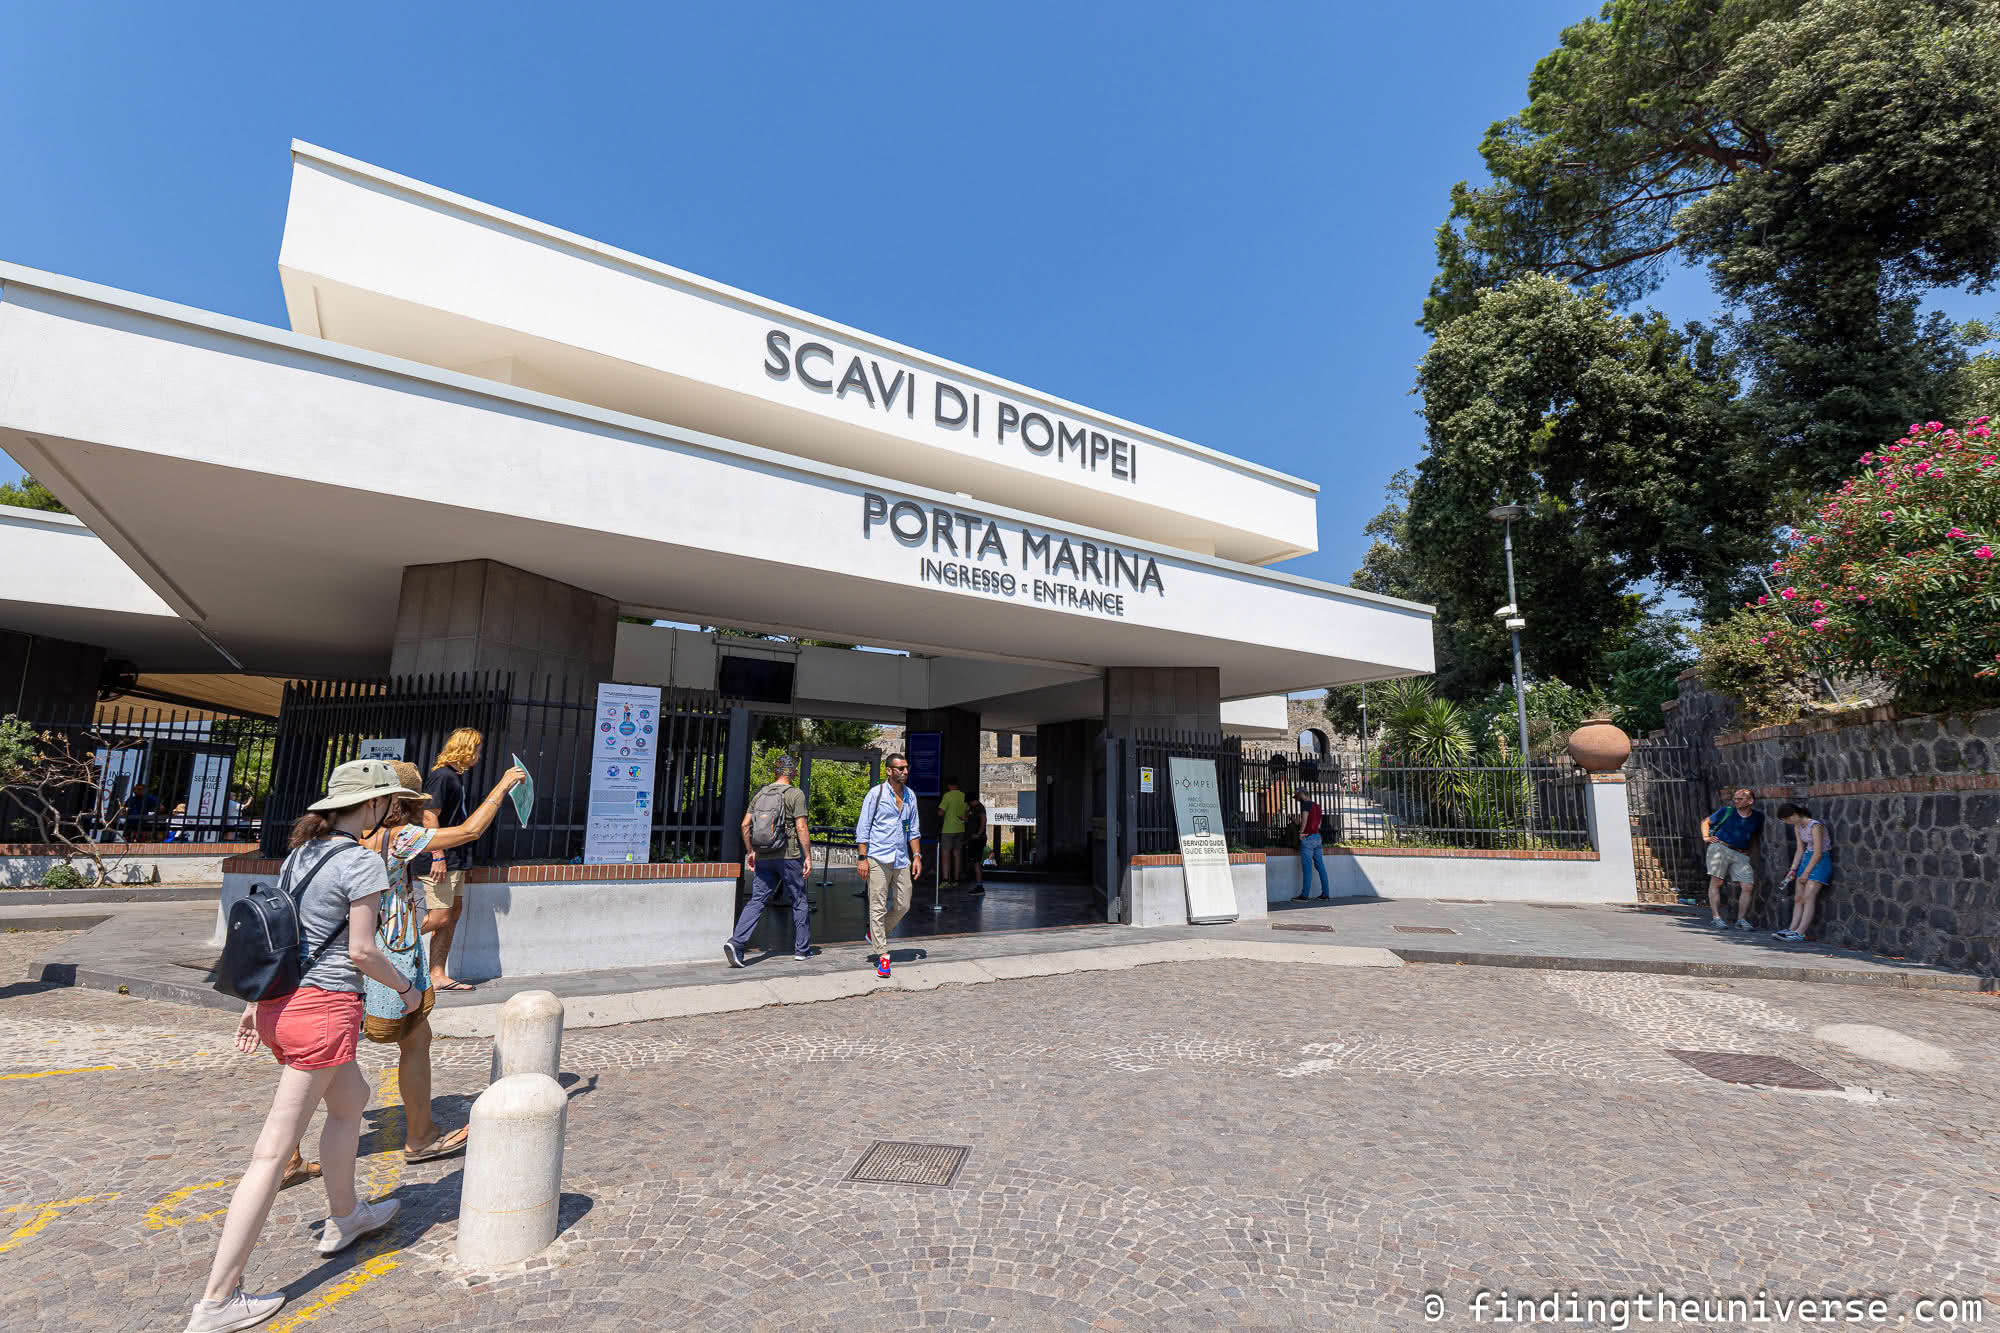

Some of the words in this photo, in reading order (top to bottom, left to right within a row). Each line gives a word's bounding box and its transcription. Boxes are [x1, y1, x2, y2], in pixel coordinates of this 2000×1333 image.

[764, 329, 914, 416] SCAVI
[935, 381, 980, 434] DI
[998, 401, 1137, 480] POMPEI
[863, 492, 1008, 560] PORTA
[1022, 528, 1165, 593] MARINA
[920, 557, 1016, 592] INGRESSO
[1033, 579, 1124, 612] ENTRANCE
[1175, 777, 1214, 789] POMPEI
[1183, 839, 1208, 847] SERVIZIO
[1184, 847, 1203, 855] GUIDE
[1203, 847, 1225, 855] SERVICE
